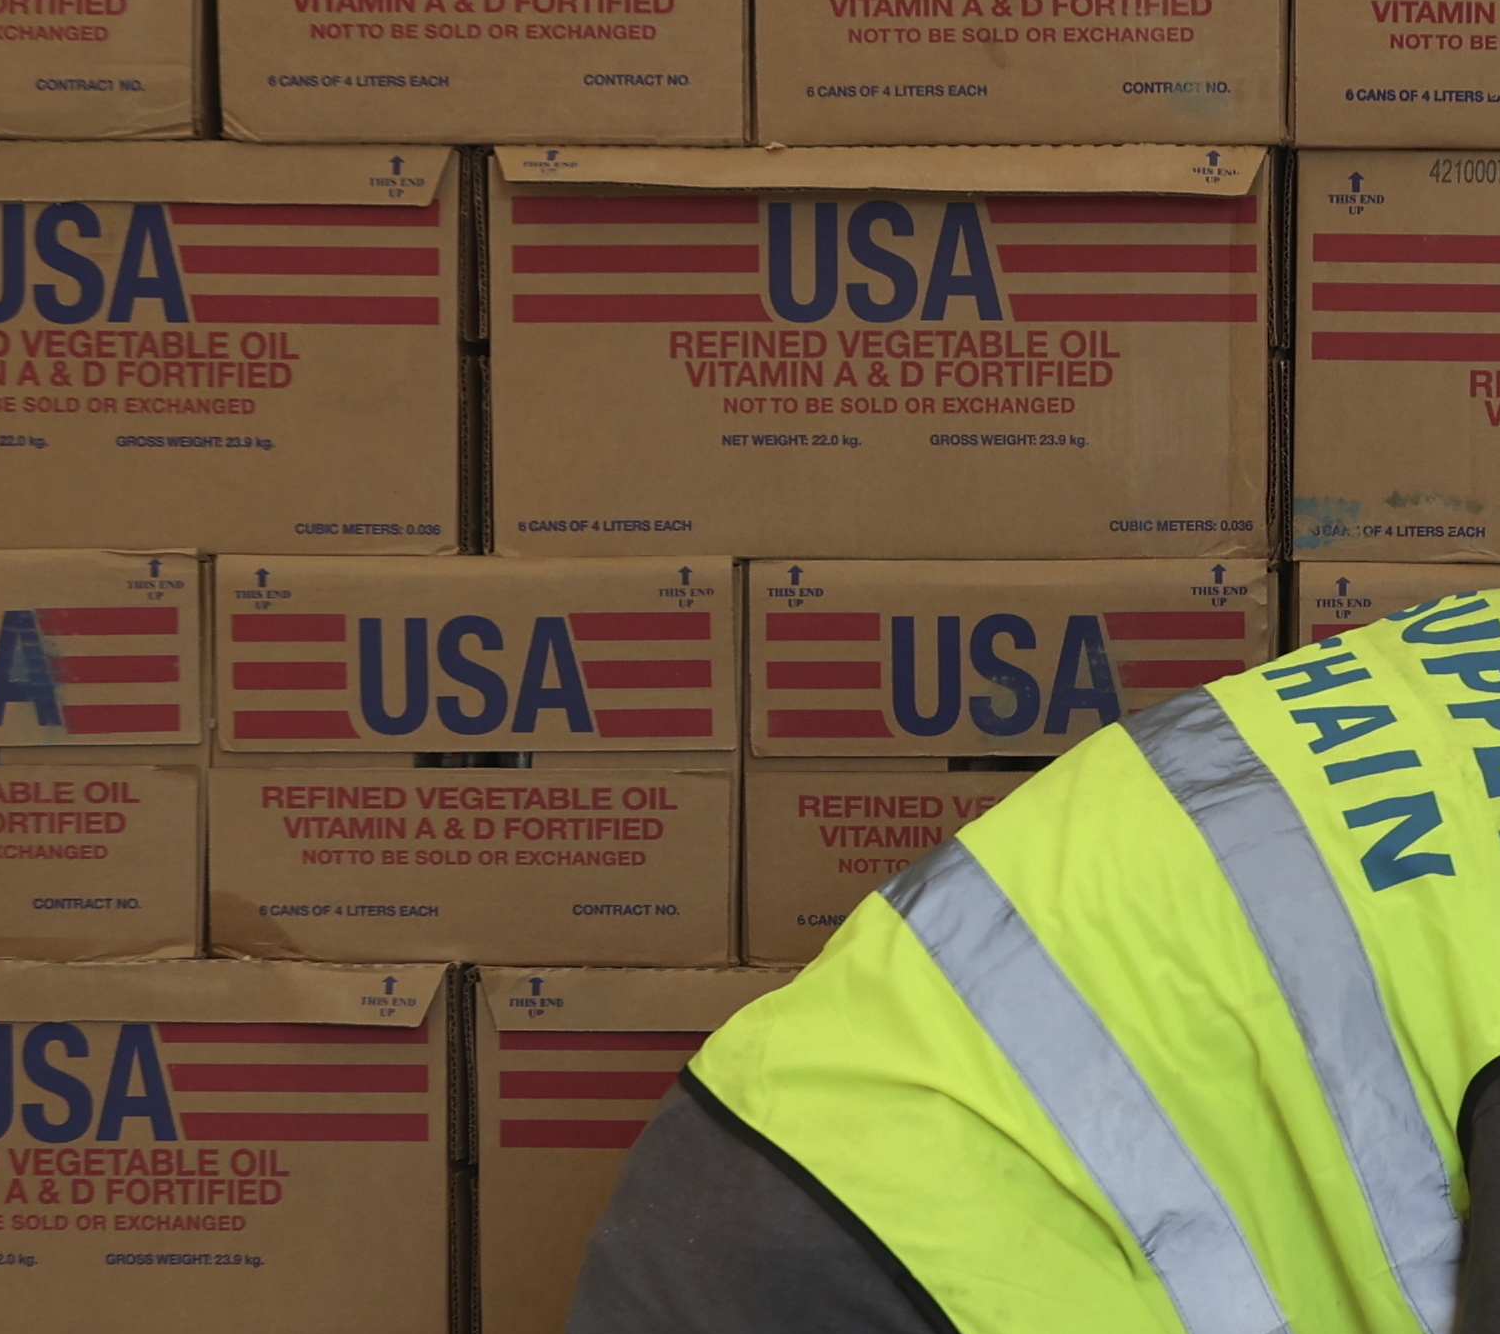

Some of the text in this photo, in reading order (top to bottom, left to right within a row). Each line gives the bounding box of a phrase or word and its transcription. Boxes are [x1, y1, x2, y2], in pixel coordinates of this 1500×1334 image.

[768, 200, 1002, 323] USA
[359, 615, 594, 735] USA
[1261, 637, 1456, 892] HAIN
